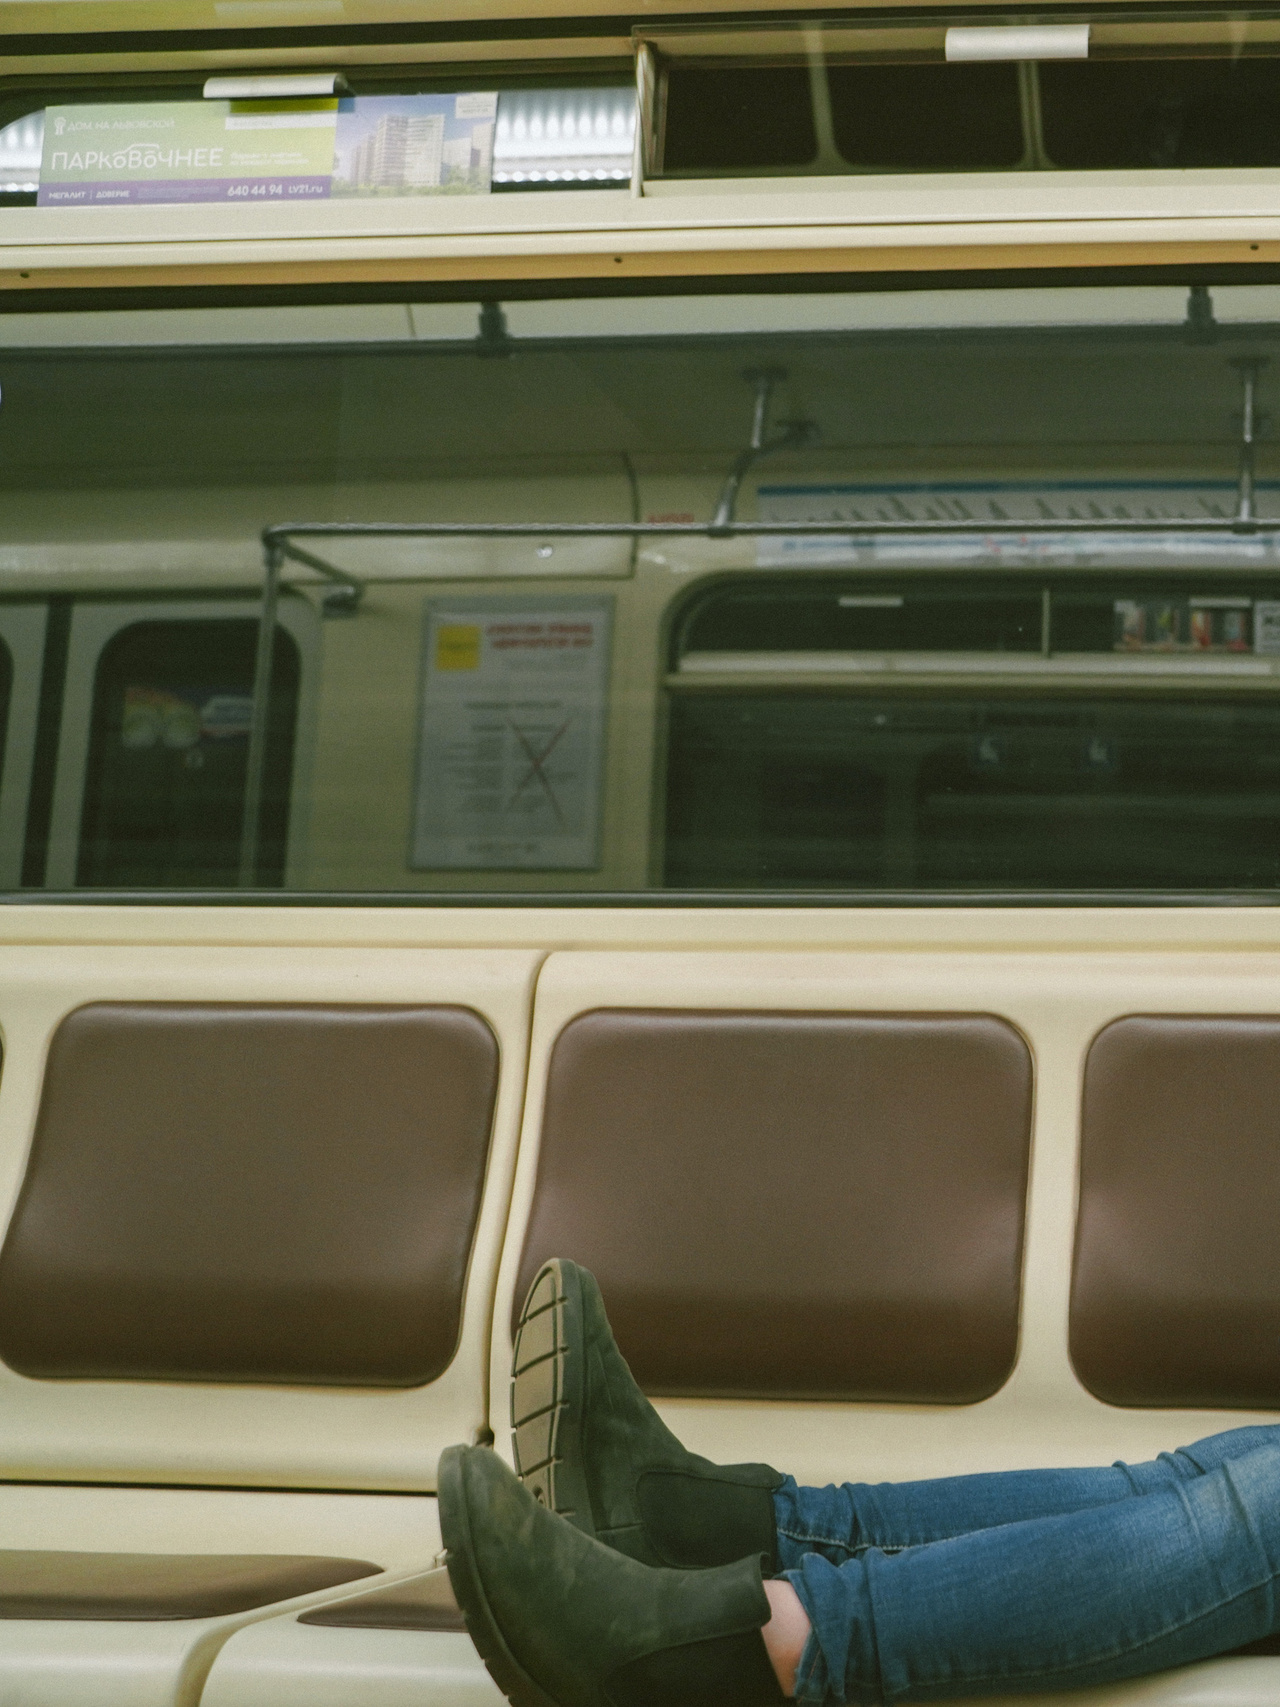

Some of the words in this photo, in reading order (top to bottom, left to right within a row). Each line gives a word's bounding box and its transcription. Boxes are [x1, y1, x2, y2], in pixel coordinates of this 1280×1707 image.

[227, 184, 249, 196] 640
[251, 184, 266, 195] 44
[269, 183, 283, 195] 94
